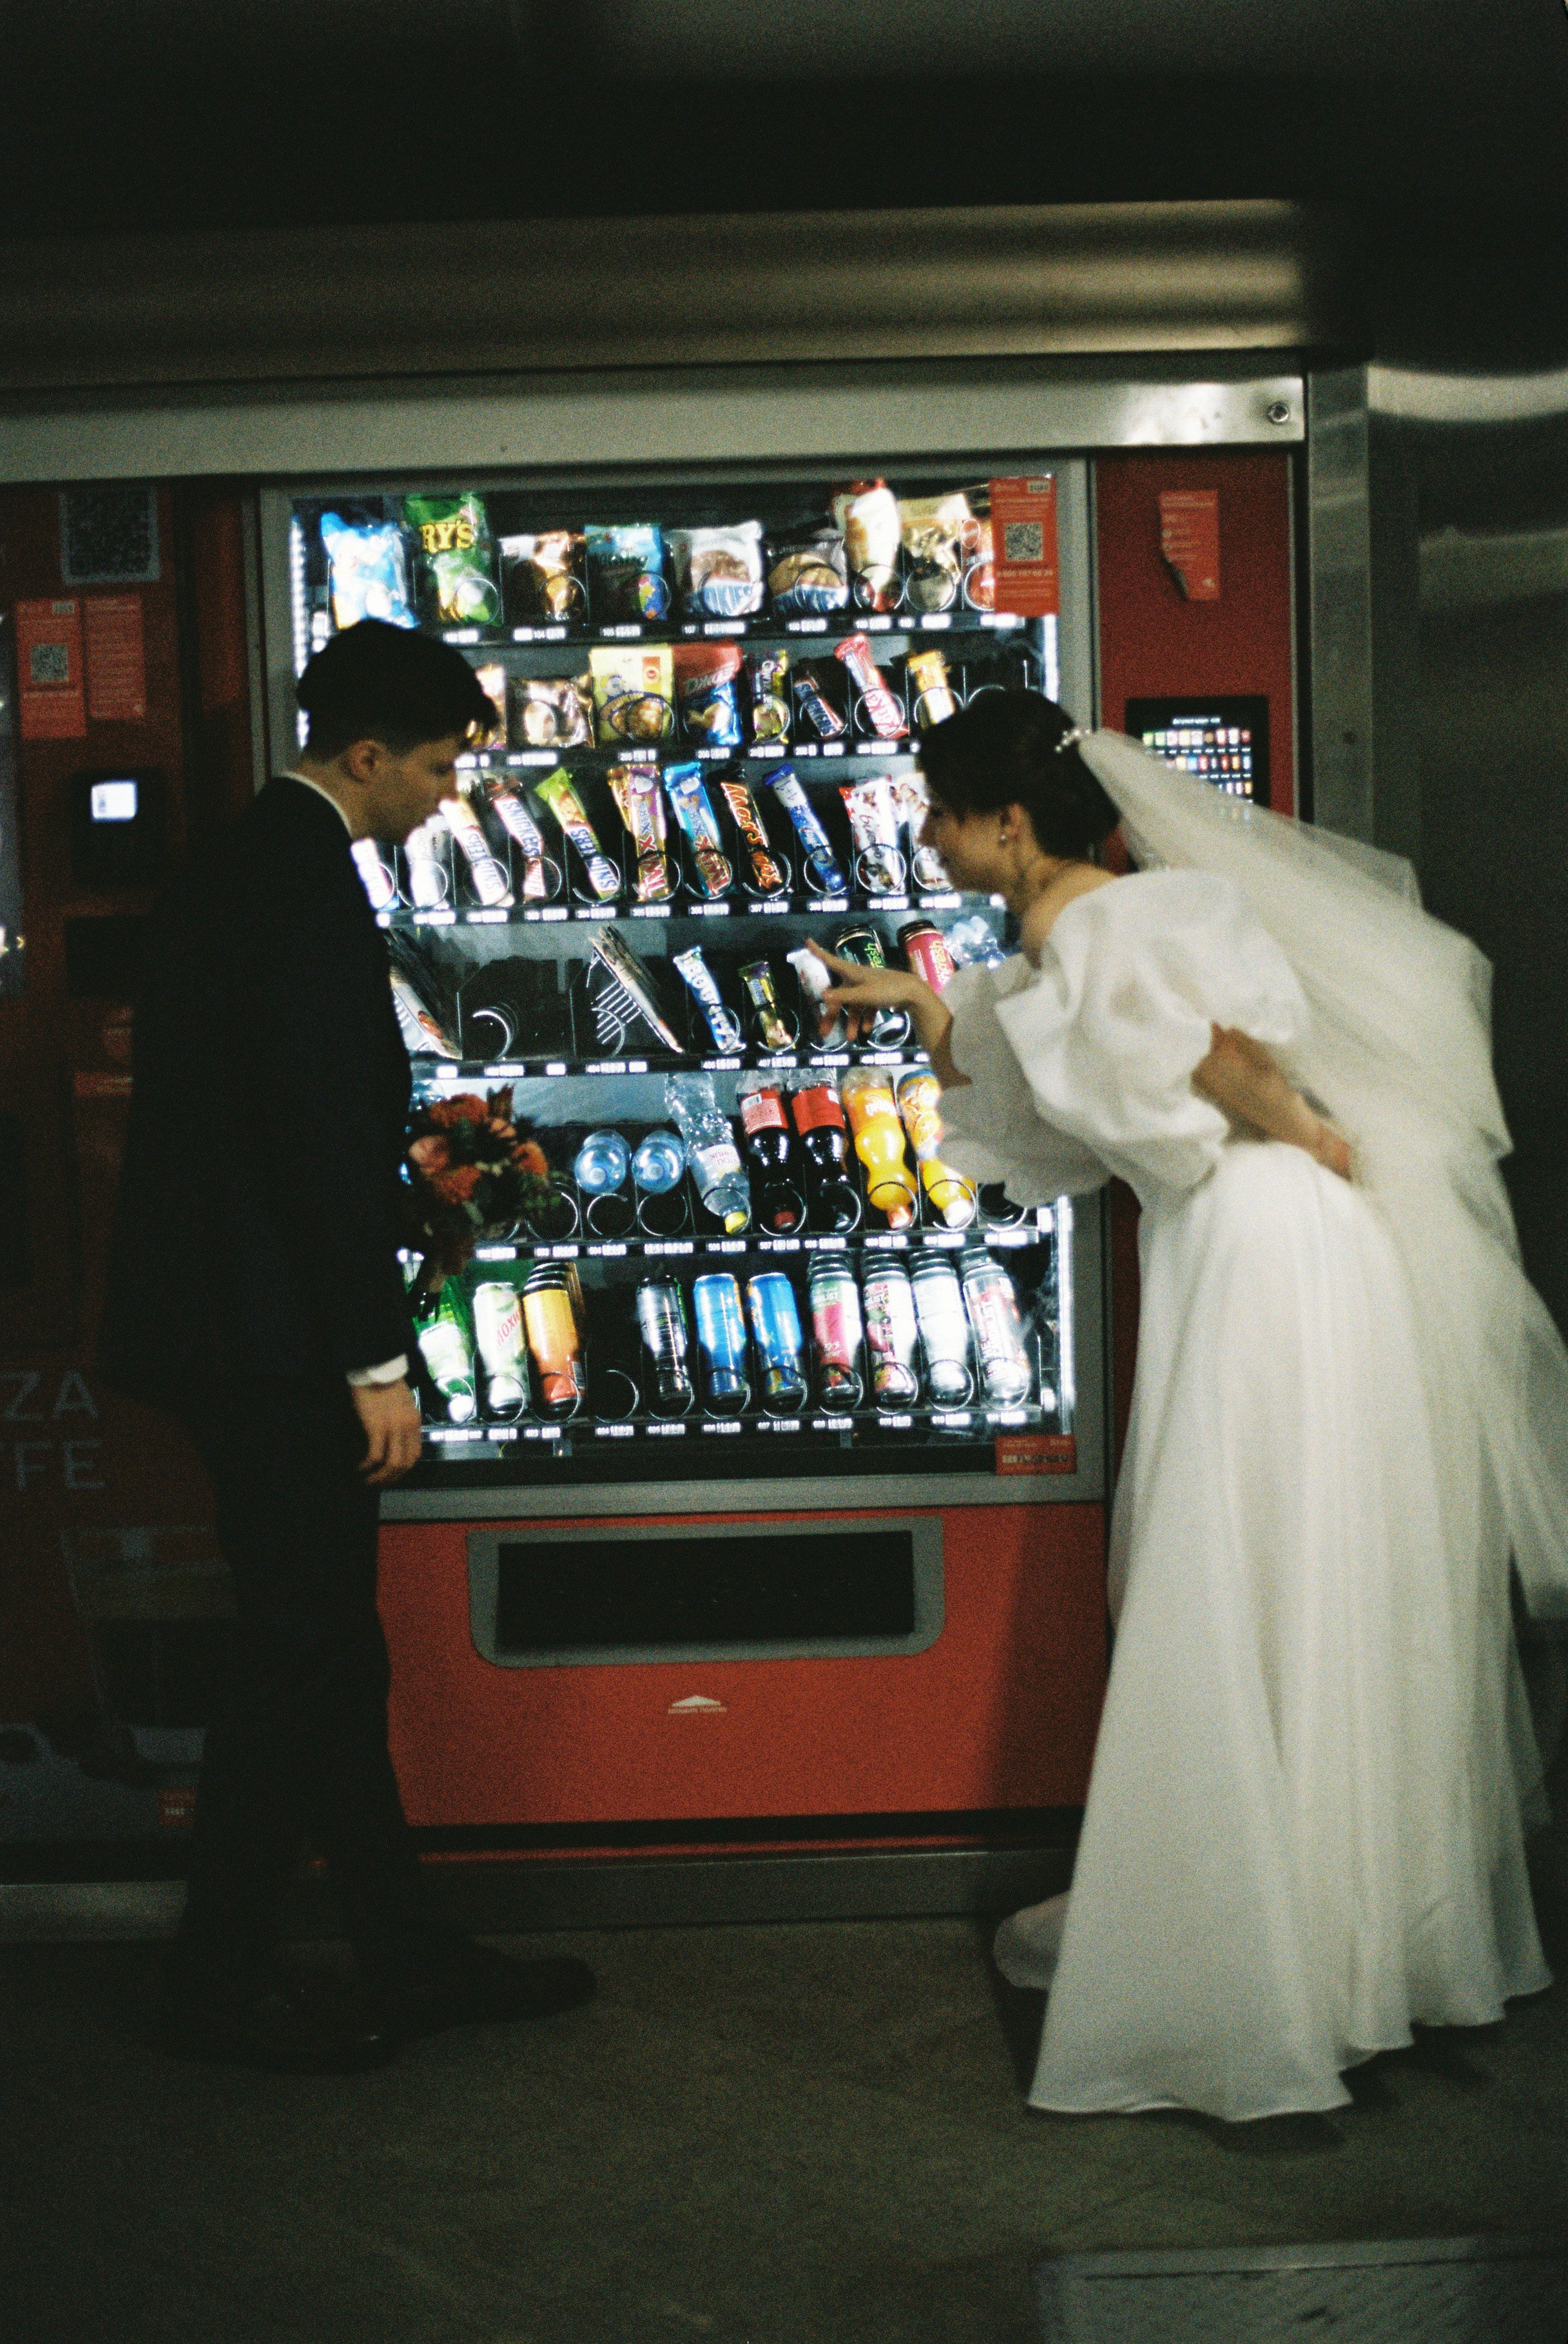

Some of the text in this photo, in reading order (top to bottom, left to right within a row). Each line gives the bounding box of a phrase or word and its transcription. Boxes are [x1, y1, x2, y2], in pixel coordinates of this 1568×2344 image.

[419, 520, 474, 553] RY'S
[720, 782, 766, 846] Mars
[466, 833, 502, 889] SNICERS
[570, 828, 617, 889] SNICERS
